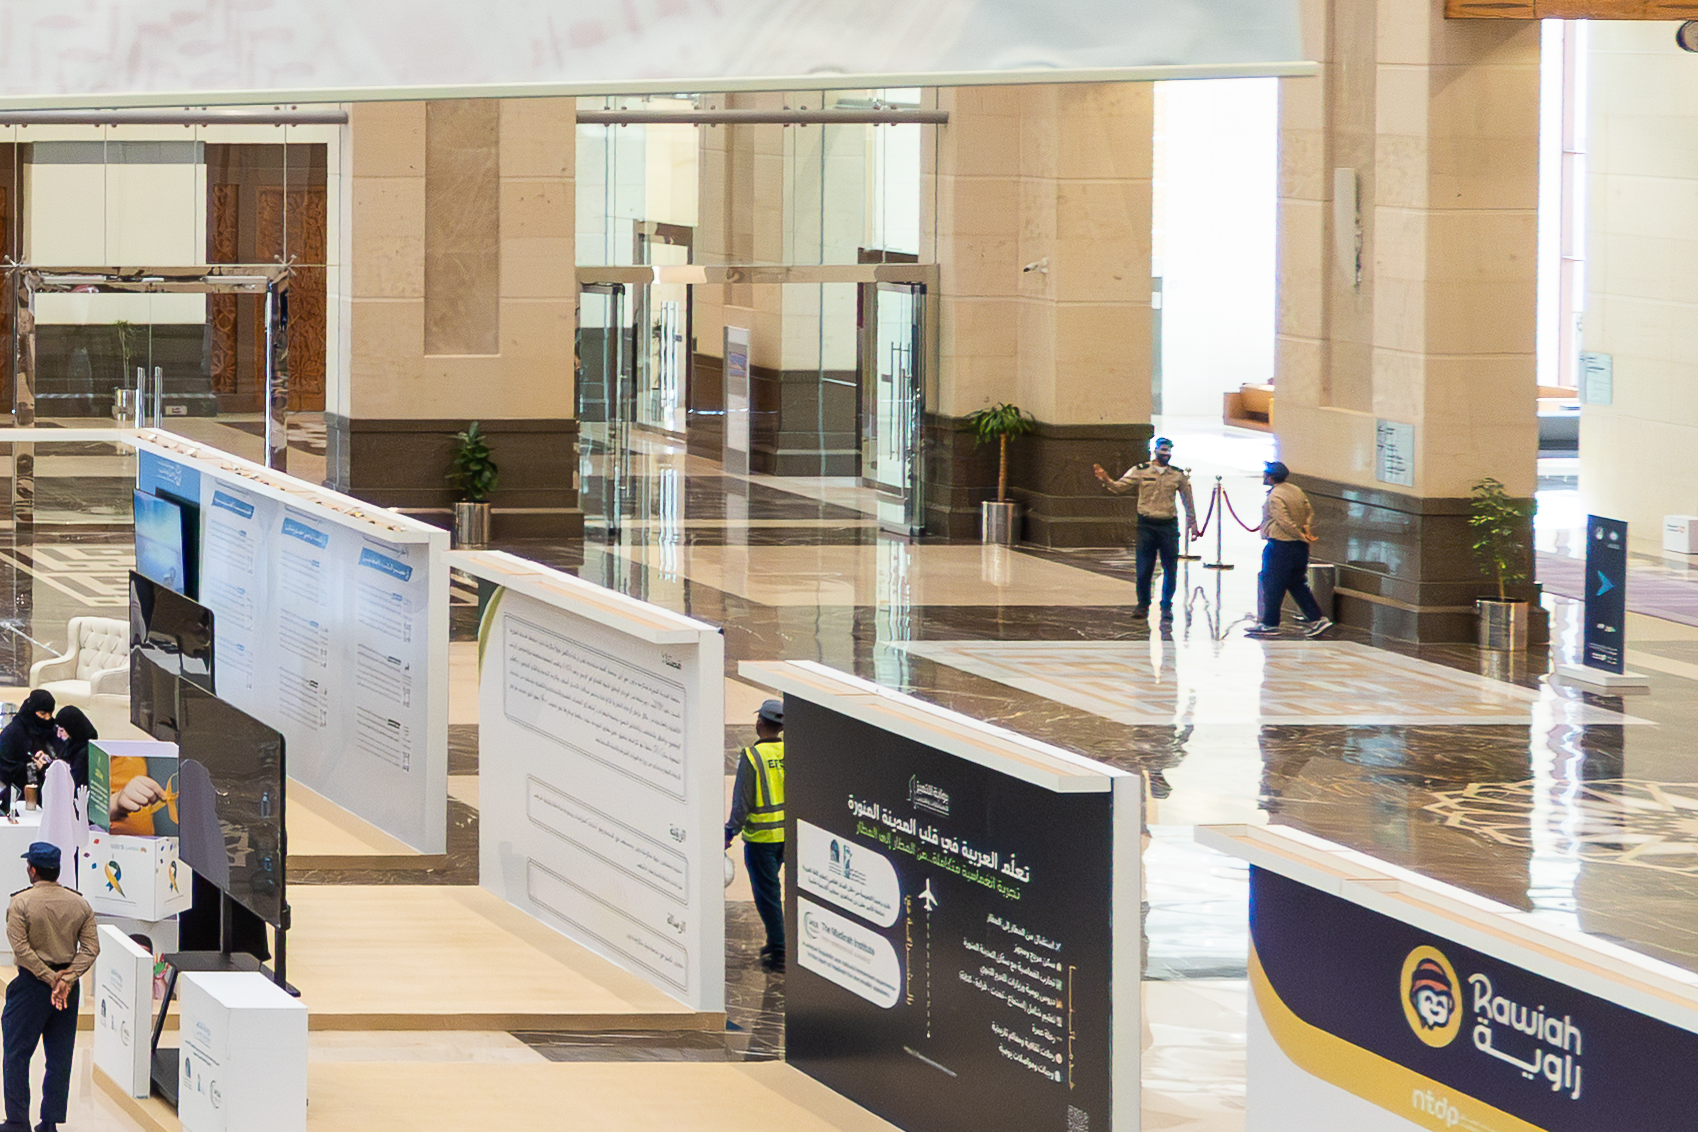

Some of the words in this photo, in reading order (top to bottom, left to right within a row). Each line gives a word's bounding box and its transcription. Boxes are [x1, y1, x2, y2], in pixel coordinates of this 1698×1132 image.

[847, 794, 879, 819] المنورة
[881, 808, 916, 834] المدينة
[918, 825, 939, 844] قلب
[940, 837, 959, 853] في
[961, 841, 998, 869] العربية
[1467, 972, 1582, 1055] Rawiah
[1472, 1016, 1582, 1100] راوية
[1410, 1088, 1460, 1128] ntdp
